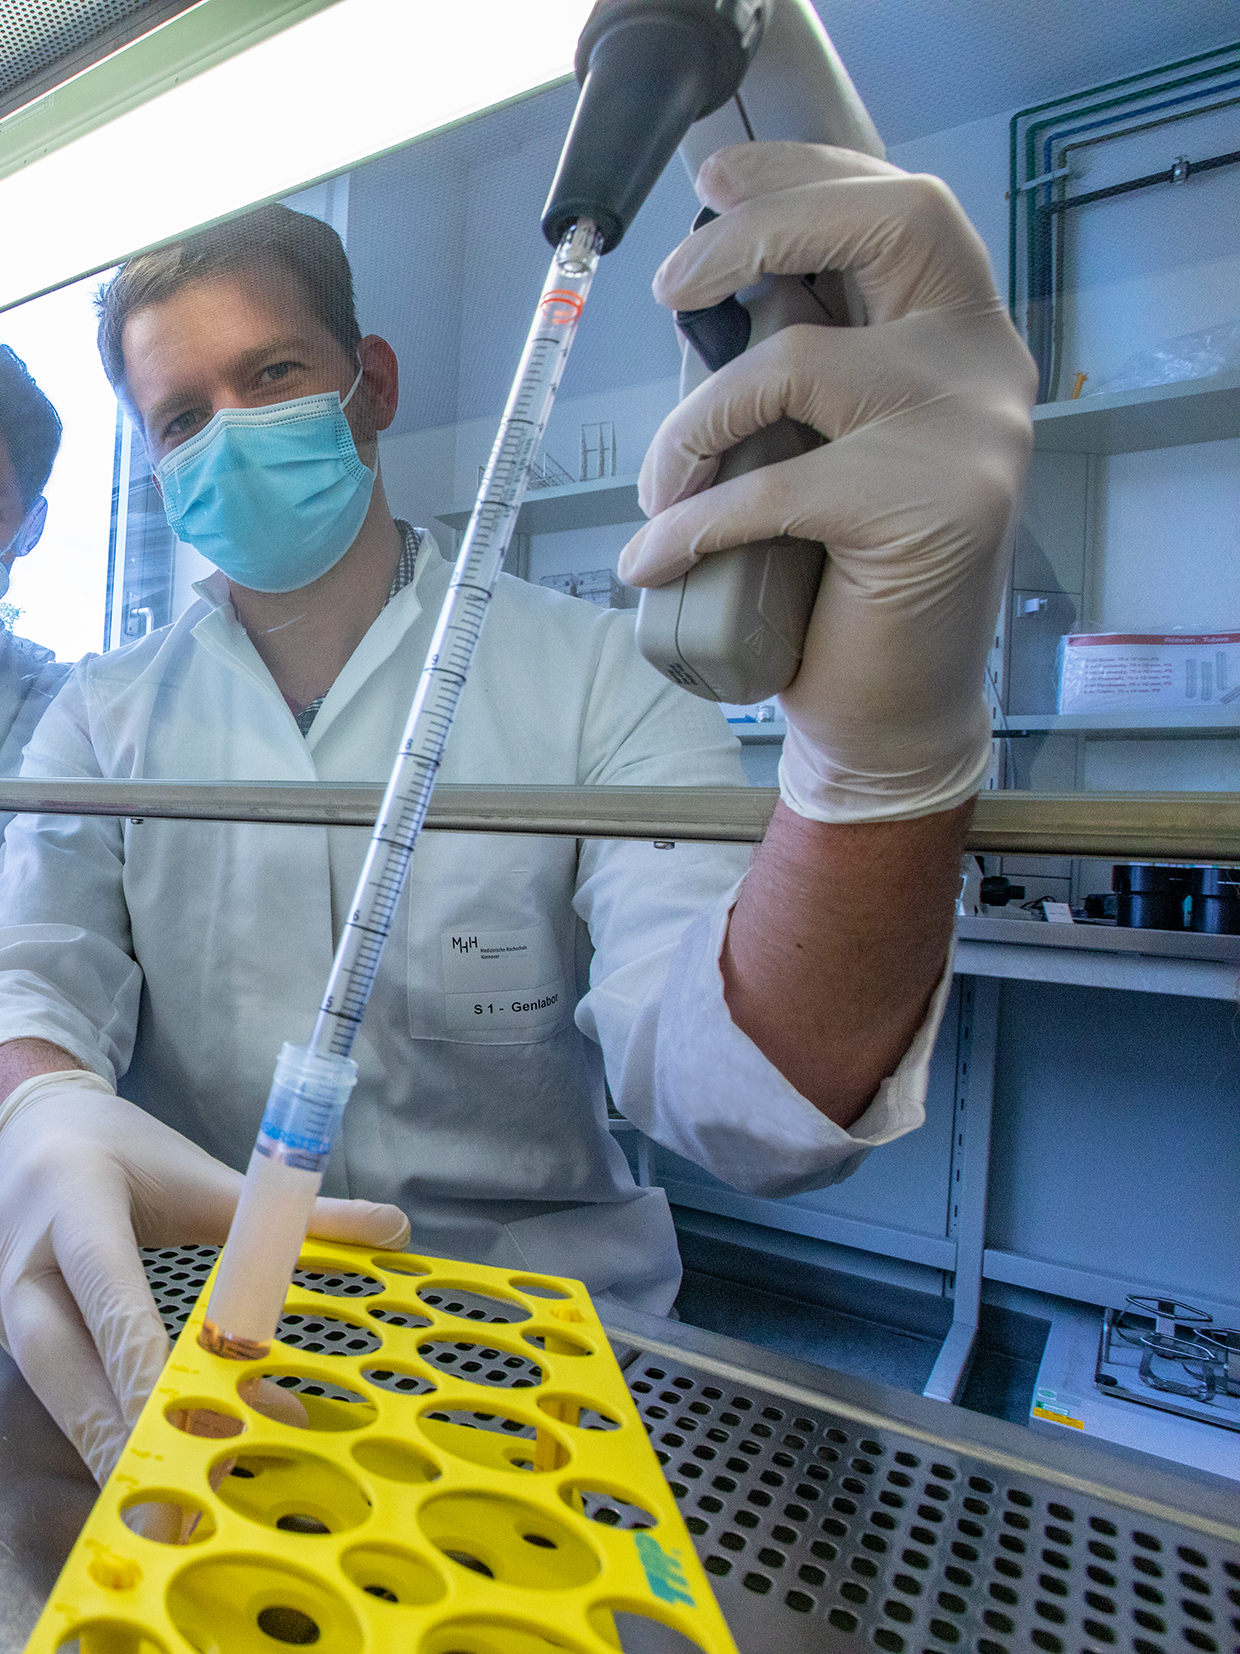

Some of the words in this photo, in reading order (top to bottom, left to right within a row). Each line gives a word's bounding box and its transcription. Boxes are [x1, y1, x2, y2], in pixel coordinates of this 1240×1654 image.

[352, 910, 360, 922] 6
[474, 1004, 483, 1015] S
[487, 1003, 494, 1014] 1
[511, 993, 559, 1013] Genlabor
